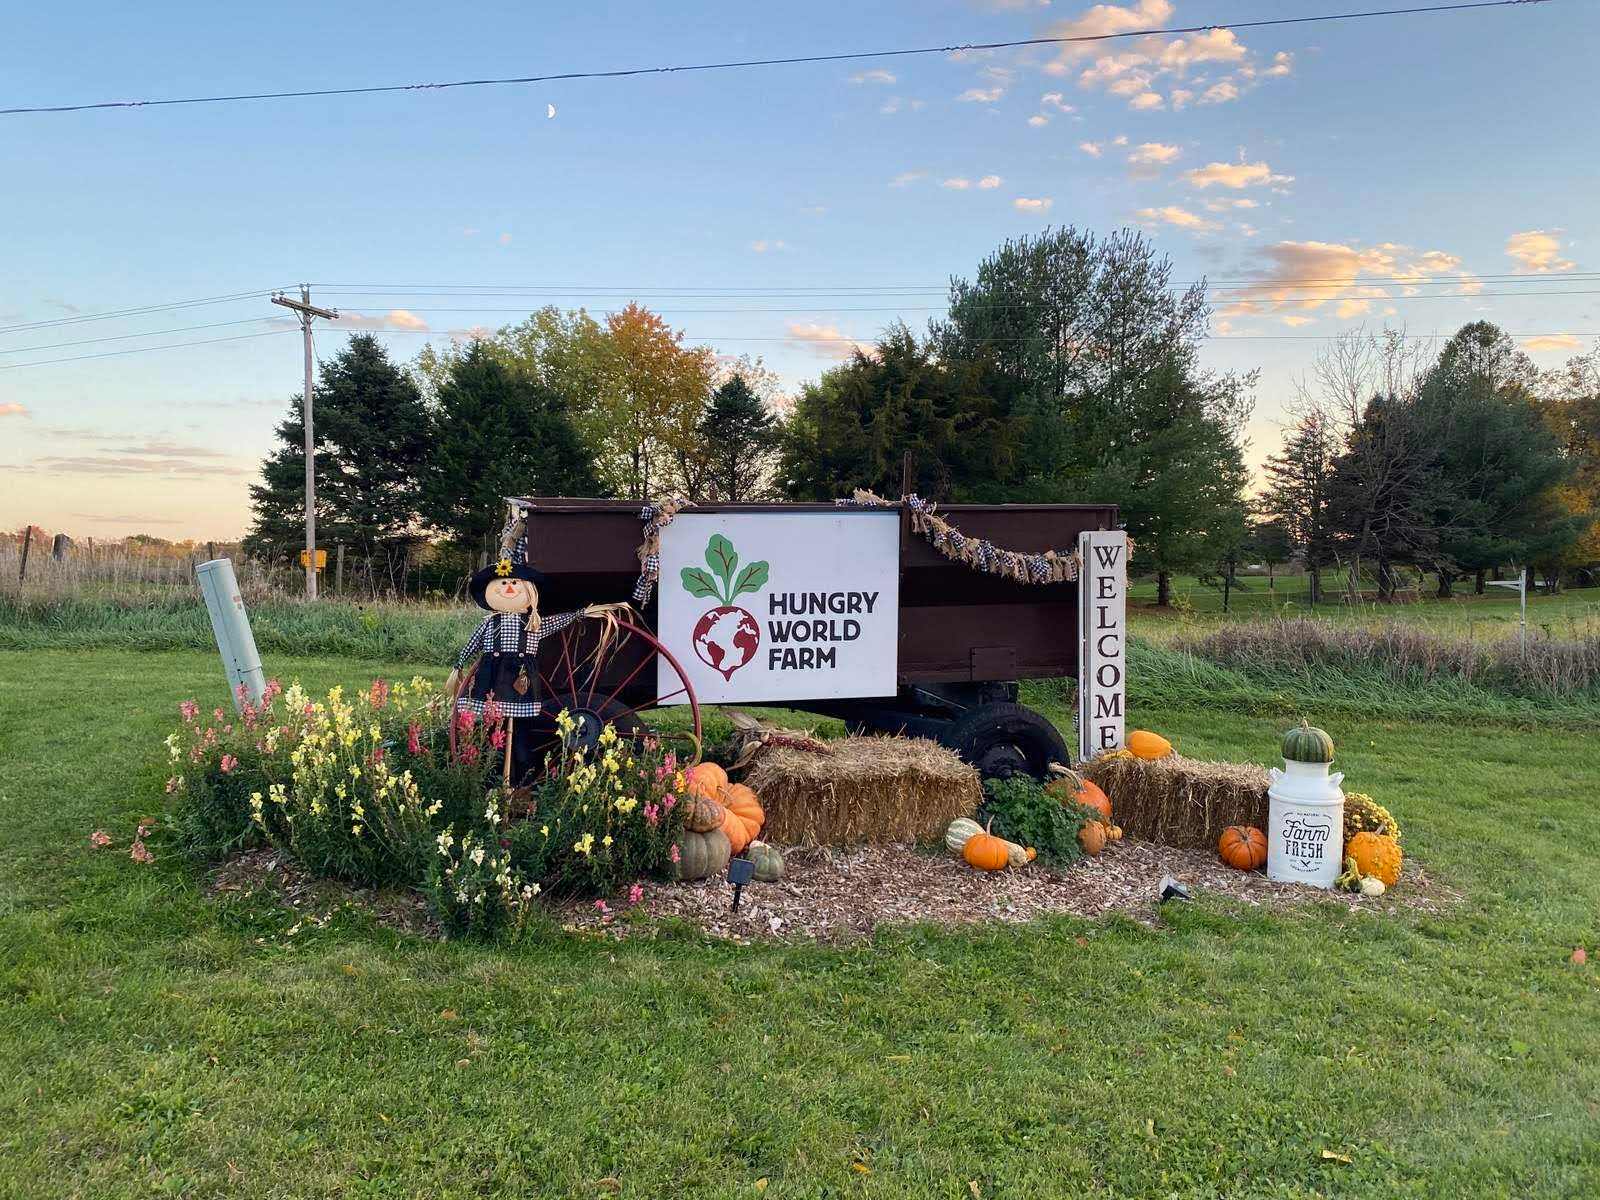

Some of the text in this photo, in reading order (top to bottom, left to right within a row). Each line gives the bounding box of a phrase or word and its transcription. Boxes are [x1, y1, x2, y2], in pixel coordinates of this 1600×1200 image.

[769, 592, 879, 615] HUNGRY
[768, 620, 861, 642] WORLD
[769, 647, 836, 670] FARM
[1094, 546, 1122, 750] WELCOME
[1282, 818, 1331, 841] Farm
[1285, 840, 1323, 858] FRESH
